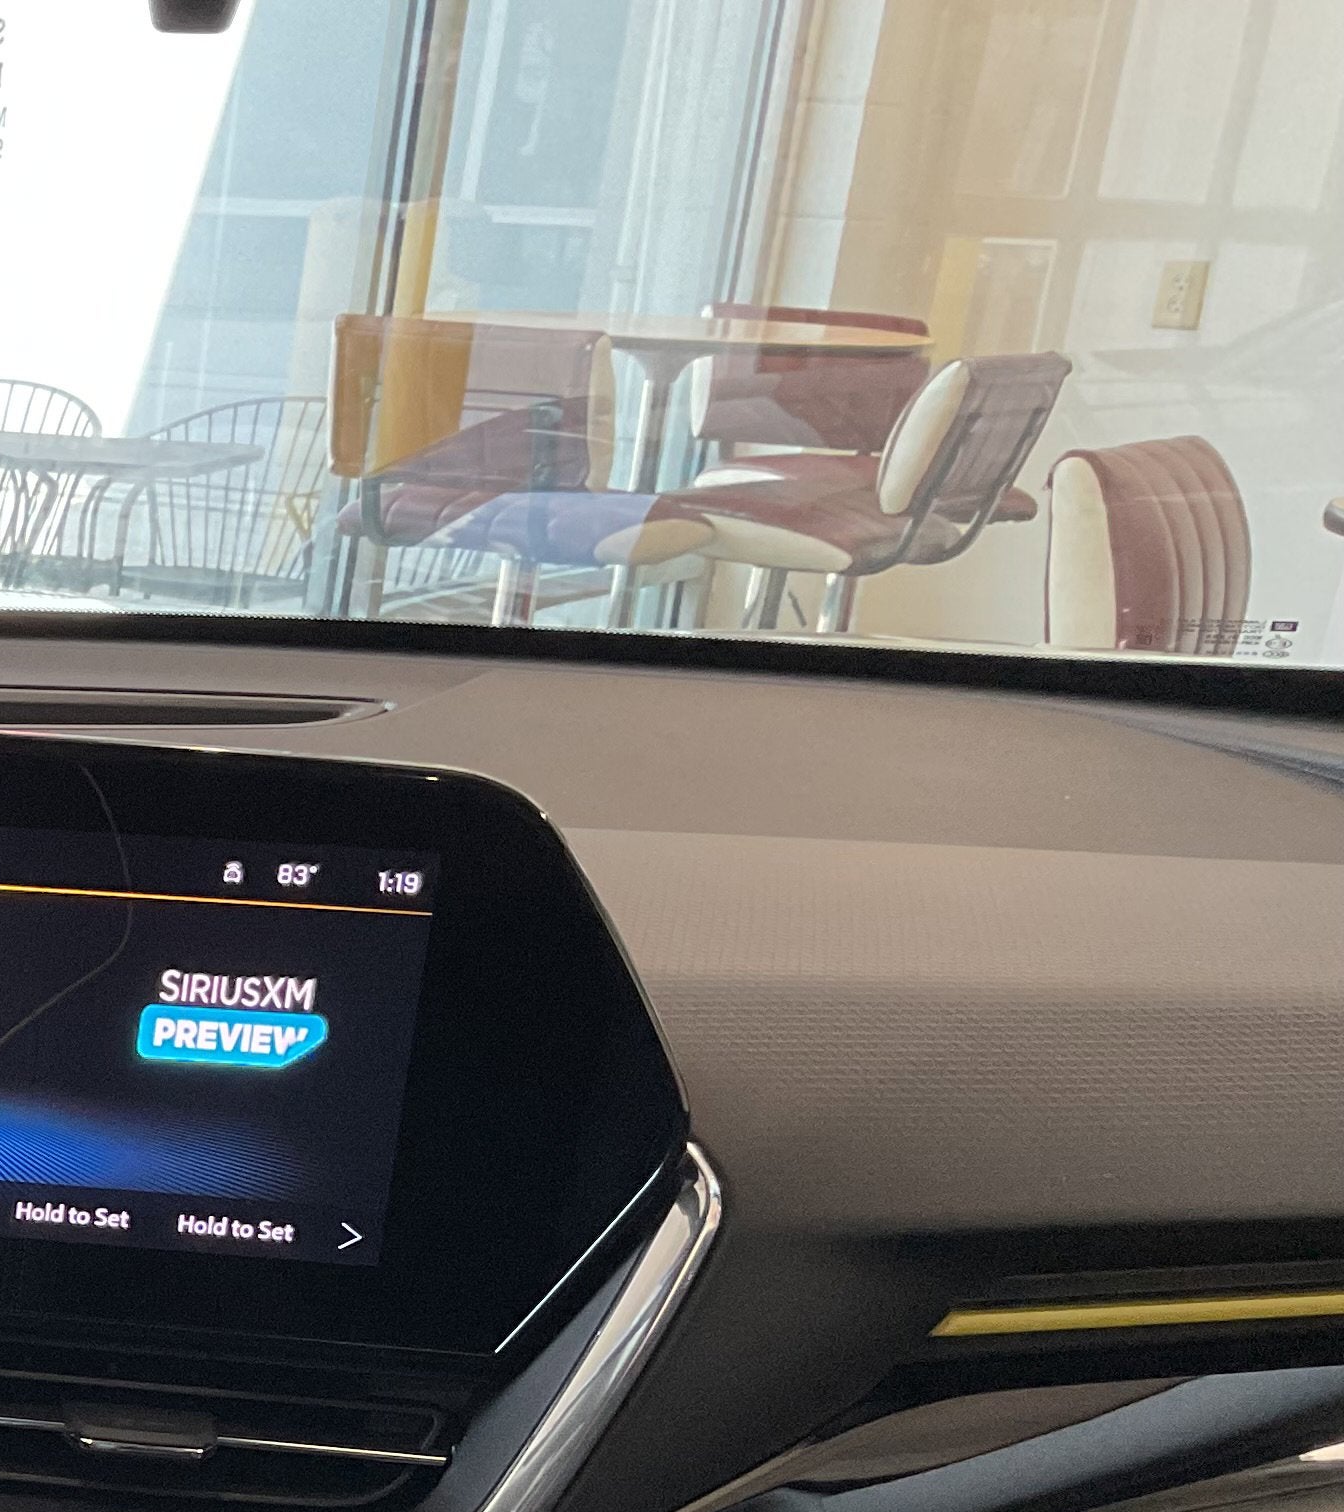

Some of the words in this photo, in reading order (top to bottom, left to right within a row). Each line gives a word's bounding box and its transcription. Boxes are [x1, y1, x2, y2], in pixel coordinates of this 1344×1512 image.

[379, 871, 422, 894] 1:19
[158, 969, 315, 1011] SIRIUSXM
[152, 1017, 309, 1055] PREVIEW
[16, 1202, 65, 1223] Hold
[68, 1207, 90, 1225] to
[94, 1208, 129, 1229] Set
[178, 1214, 228, 1237] Hold
[231, 1220, 254, 1238] to
[258, 1221, 294, 1241] Set
